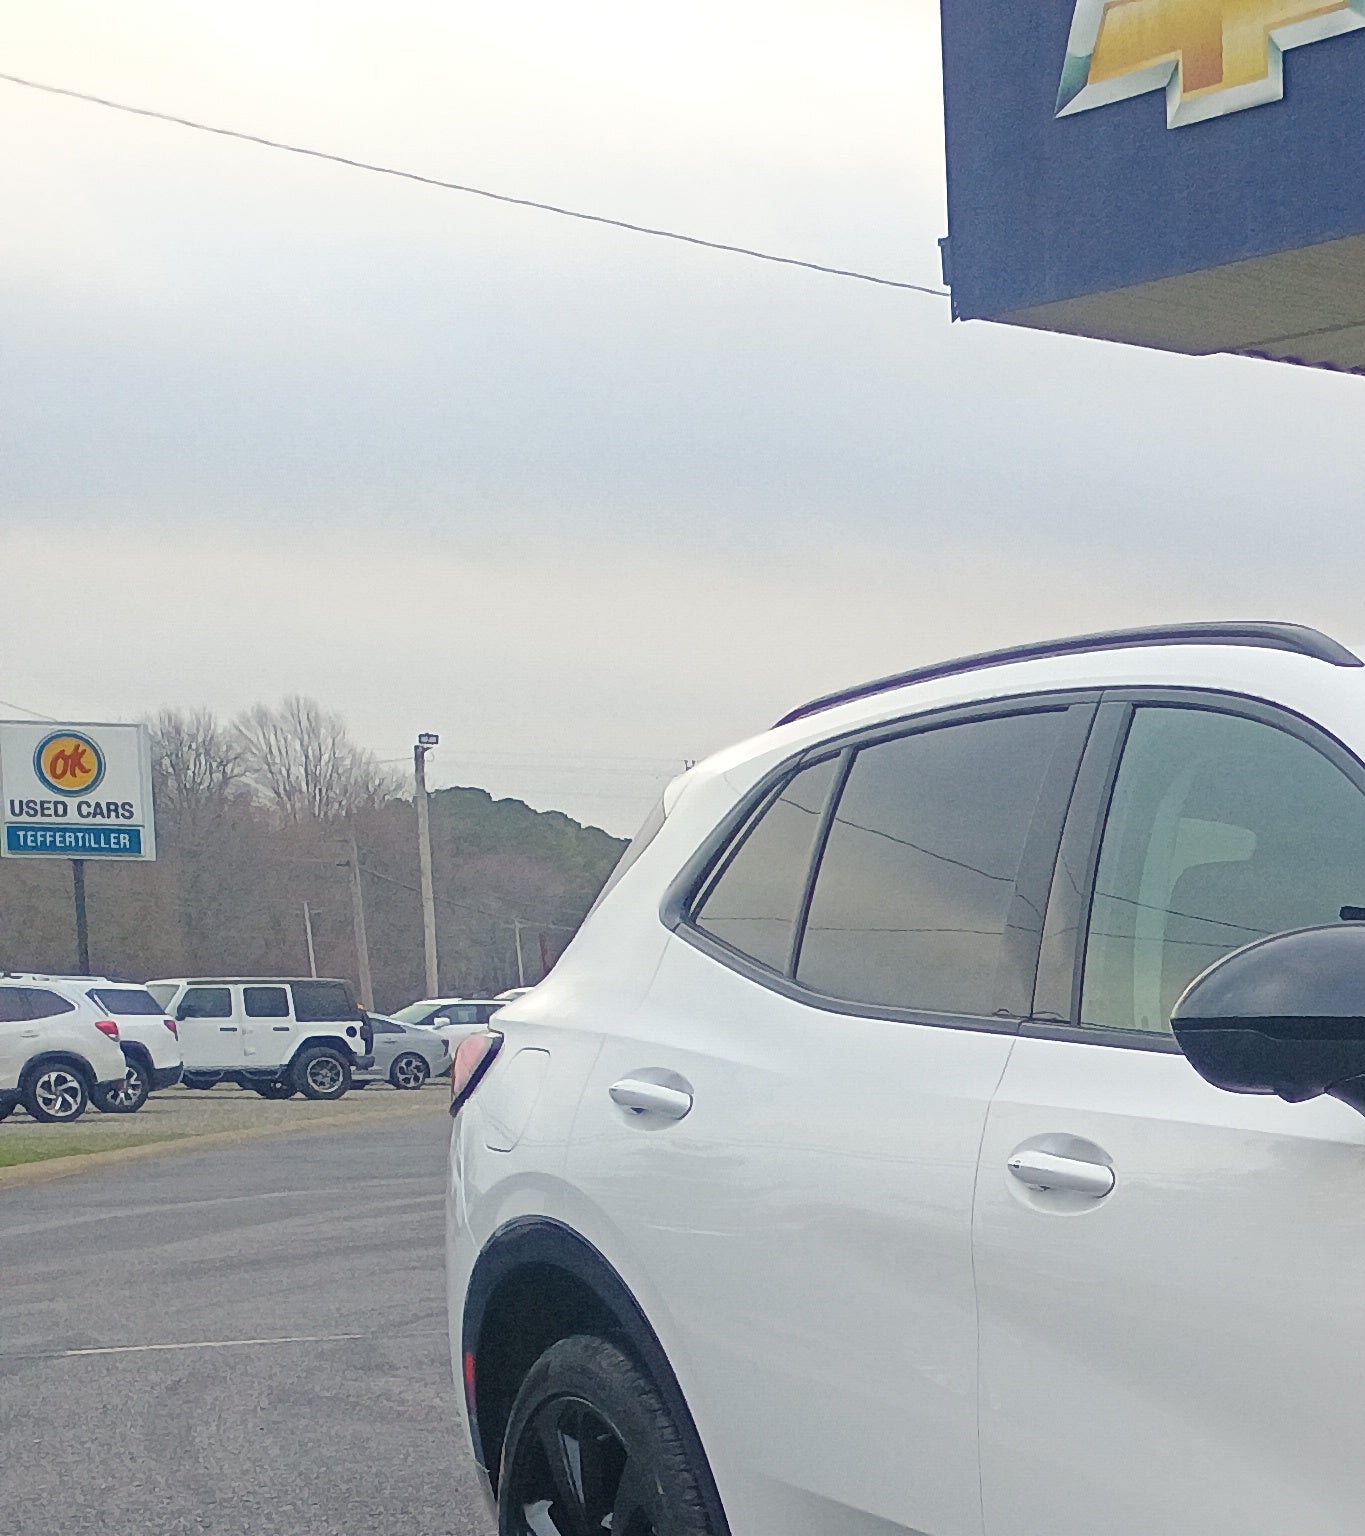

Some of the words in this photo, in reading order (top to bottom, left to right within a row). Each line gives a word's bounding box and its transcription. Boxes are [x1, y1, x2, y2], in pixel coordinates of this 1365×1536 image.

[50, 743, 91, 779] OK
[9, 799, 68, 818] USED
[76, 800, 135, 819] CARS
[16, 830, 130, 849] TEFFERTILLER
